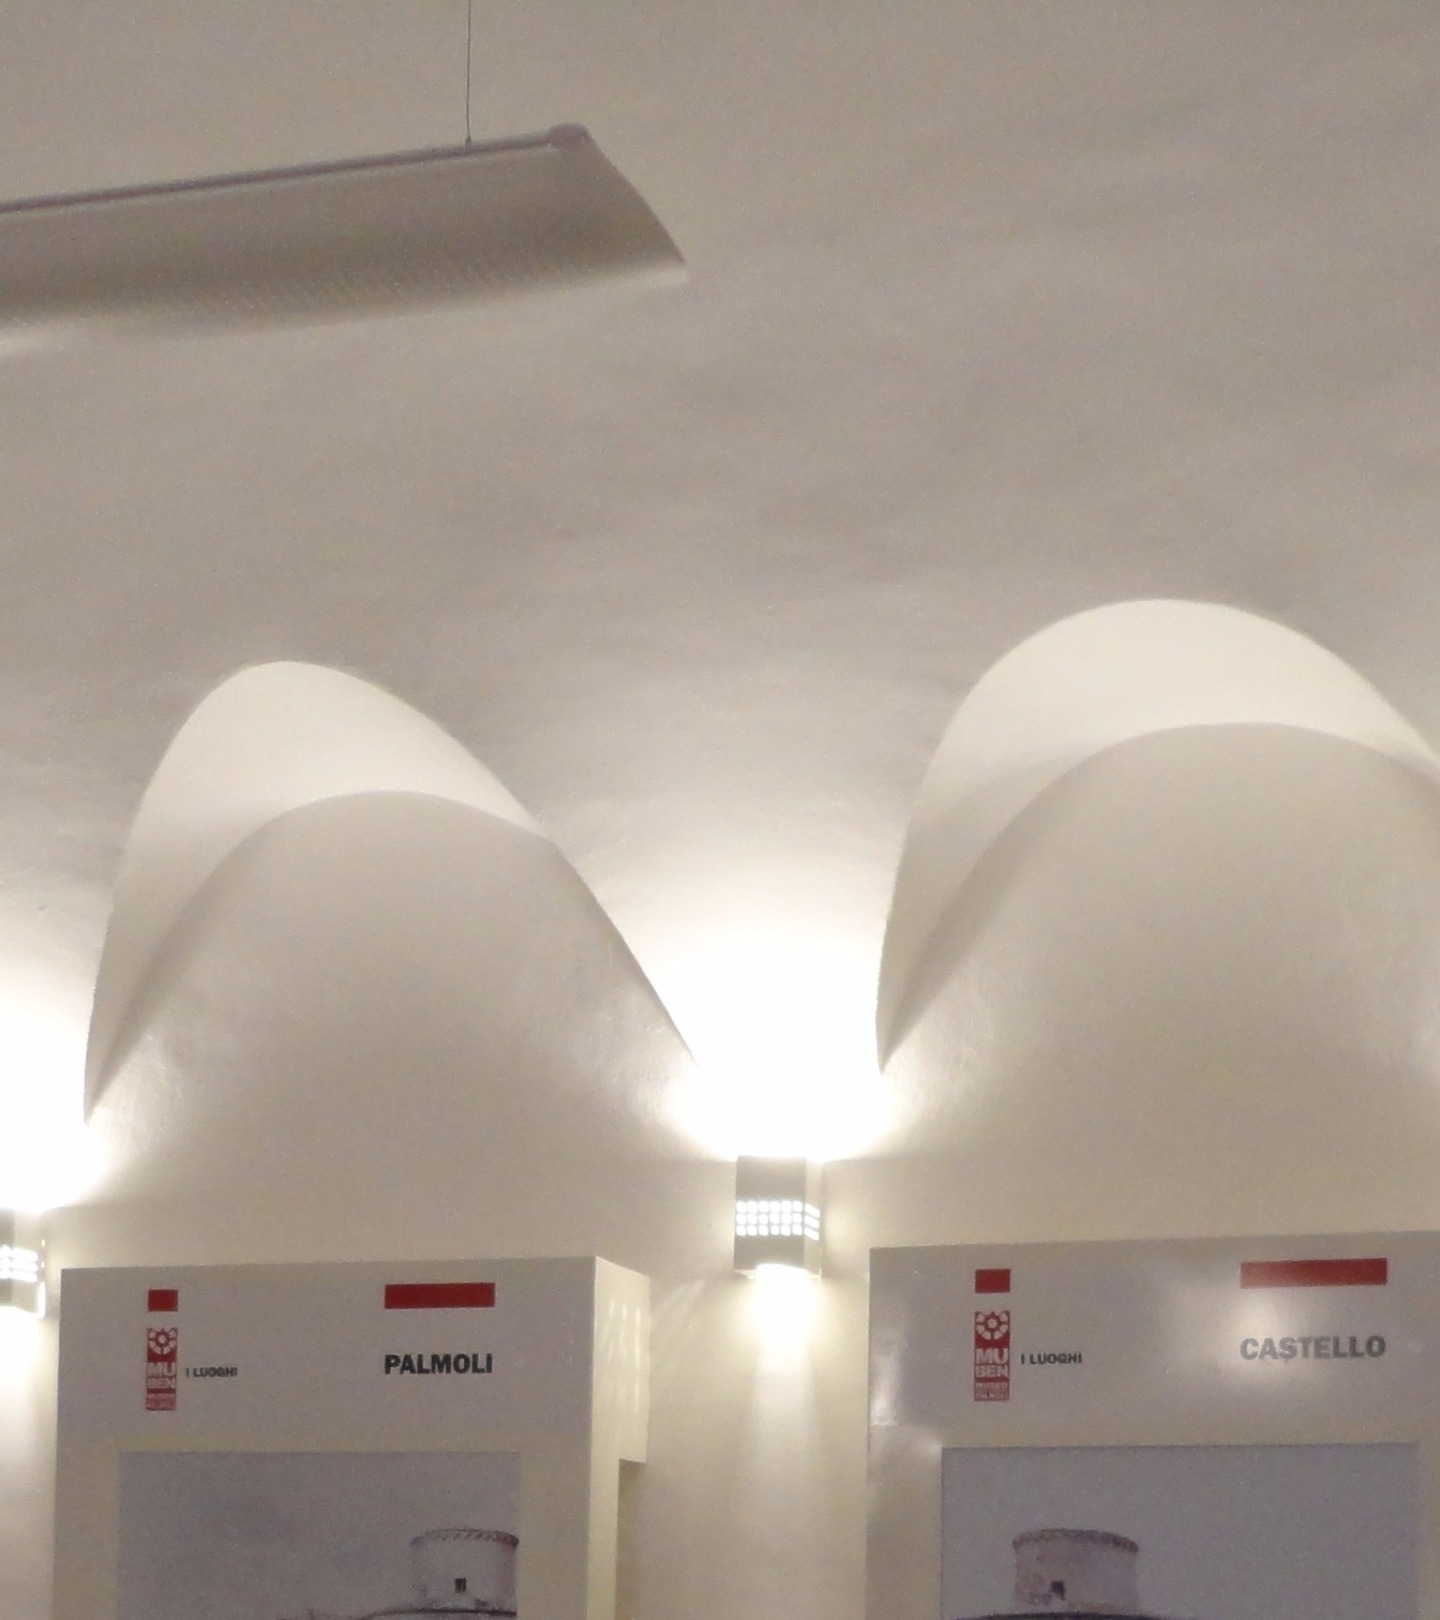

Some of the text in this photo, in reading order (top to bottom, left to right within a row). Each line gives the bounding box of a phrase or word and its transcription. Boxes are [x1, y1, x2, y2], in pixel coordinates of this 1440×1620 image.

[976, 1348, 1008, 1364] MU
[1239, 1335, 1387, 1361] CASTELLO
[384, 1353, 494, 1375] PALMOLI
[1029, 1352, 1083, 1365] LUOGHI
[193, 1367, 238, 1378] LUOGHI
